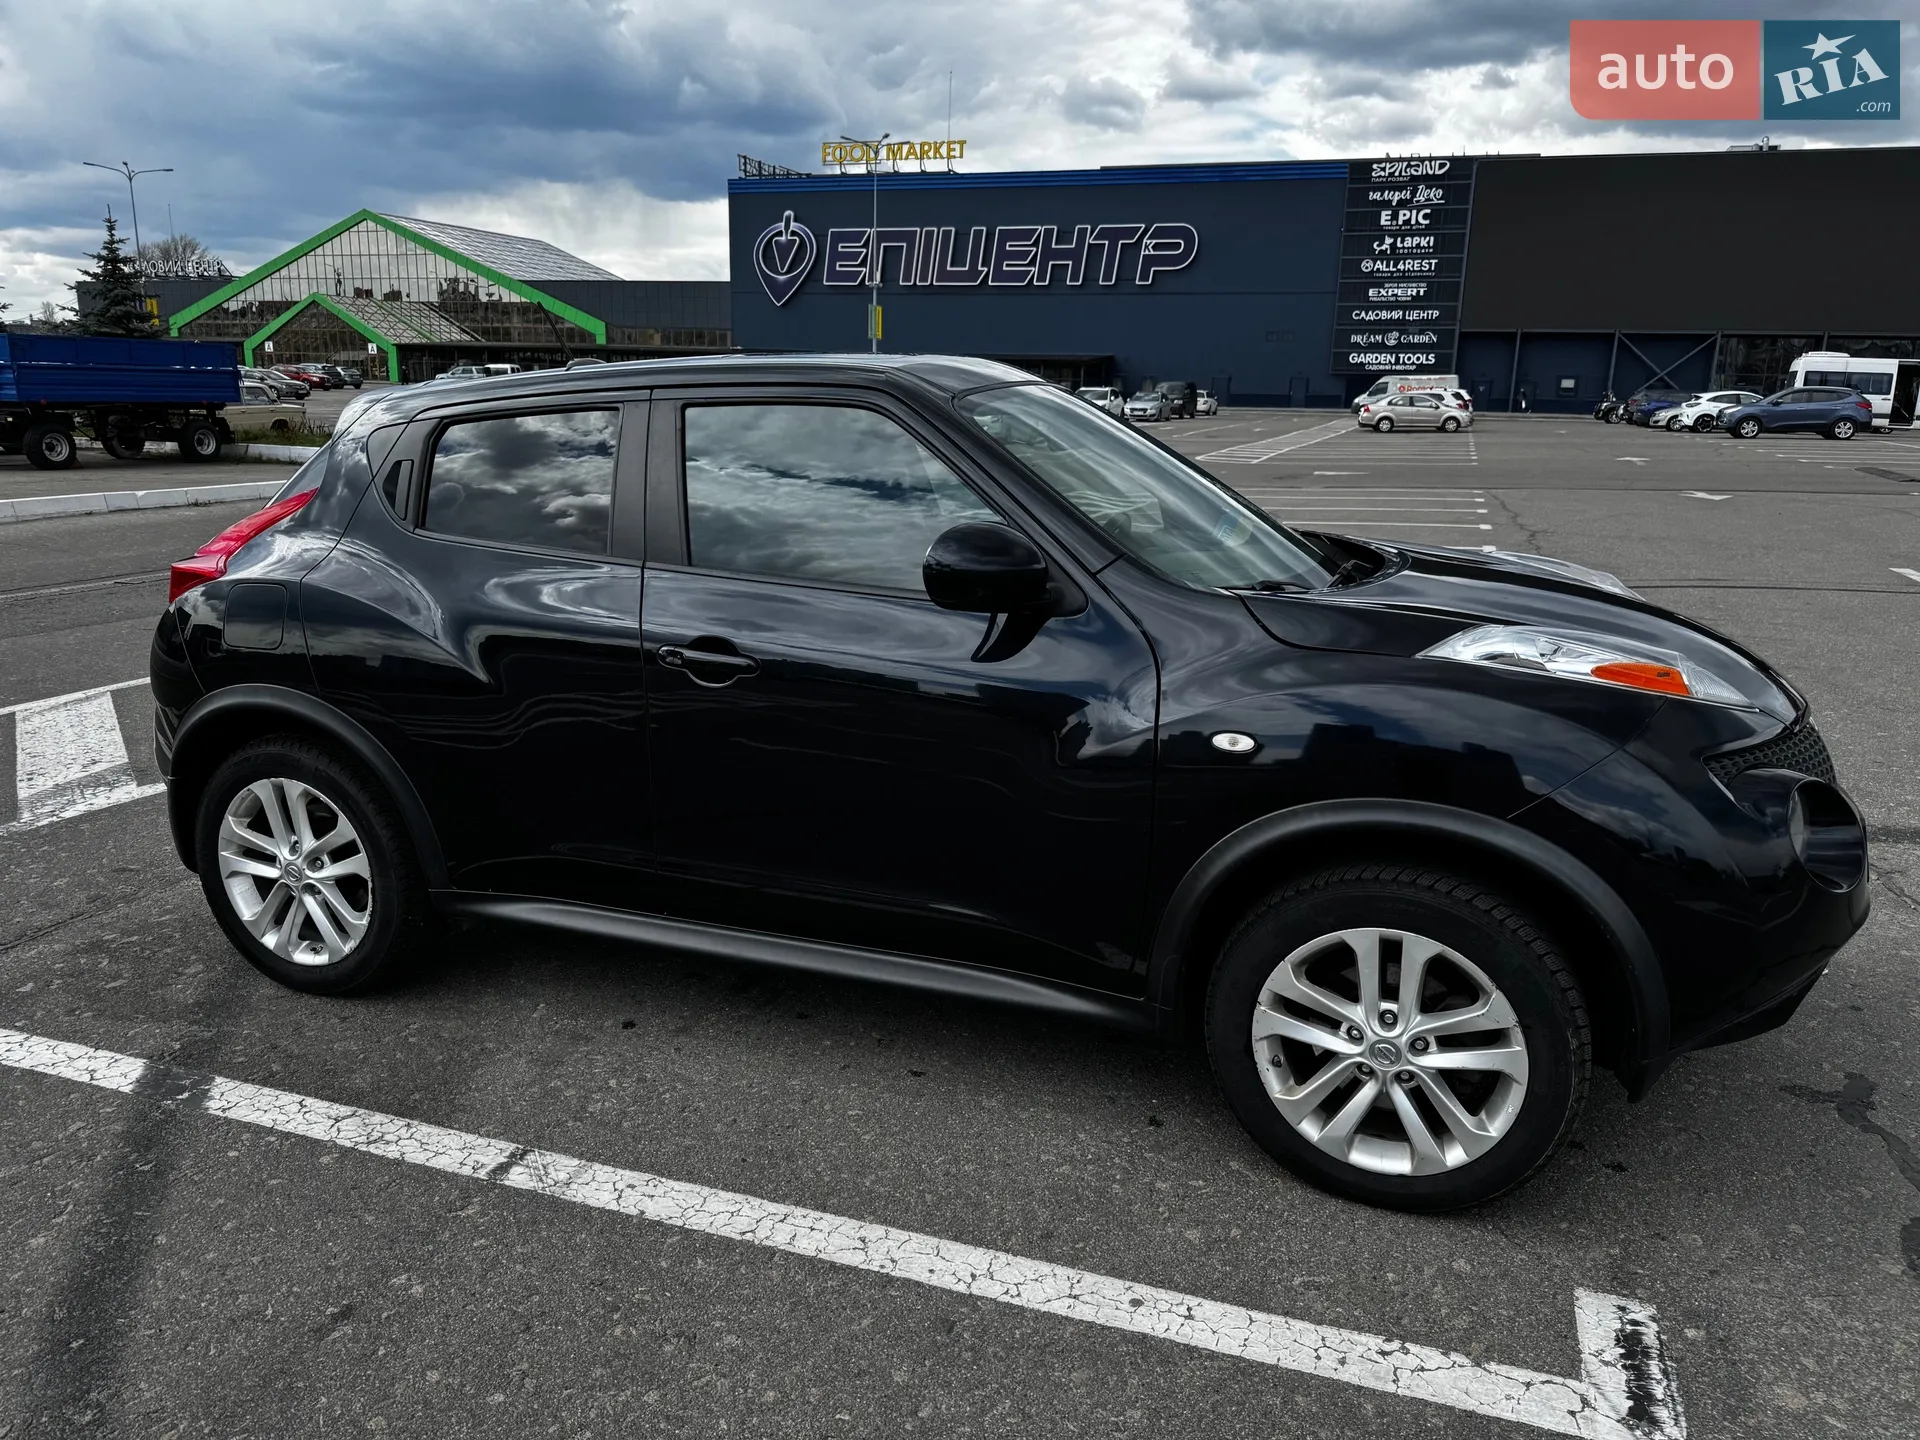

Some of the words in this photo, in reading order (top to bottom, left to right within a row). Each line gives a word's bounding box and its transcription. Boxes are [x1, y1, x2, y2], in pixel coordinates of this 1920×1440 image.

[821, 143, 880, 163] FOOD
[885, 140, 967, 161] MARKET
[1380, 209, 1431, 226] E.PIC
[822, 222, 1199, 286] ЕПІЦЕНТР
[1373, 259, 1438, 272] ALL4REST
[1368, 288, 1428, 297] EXPERT
[1352, 309, 1403, 321] САДОВИЙ
[1405, 310, 1440, 321] ЦЕНТР
[1400, 331, 1438, 344] GARDEN
[1349, 353, 1396, 364] GARDEN
[1398, 353, 1436, 364] TOOLS
